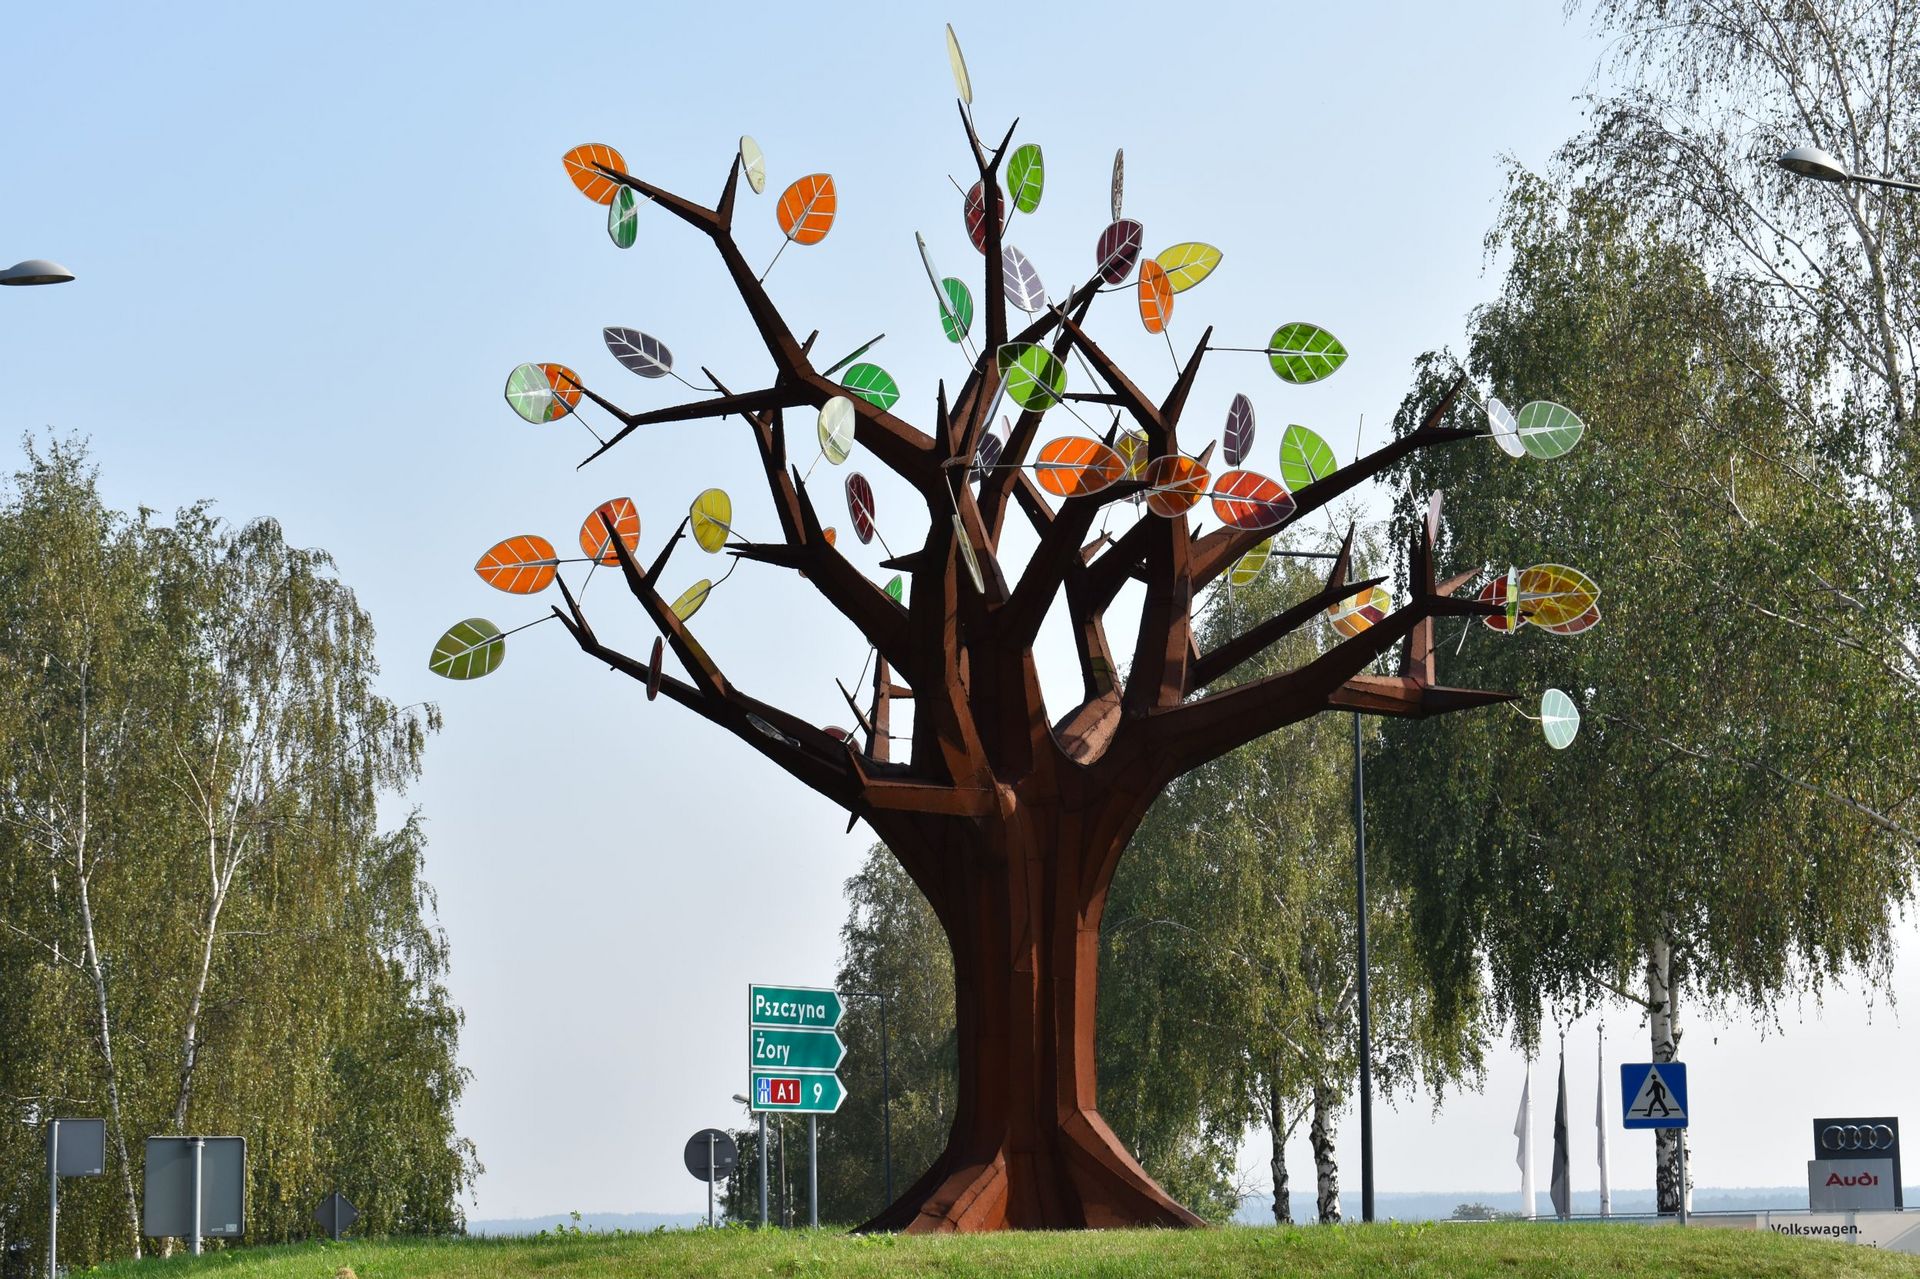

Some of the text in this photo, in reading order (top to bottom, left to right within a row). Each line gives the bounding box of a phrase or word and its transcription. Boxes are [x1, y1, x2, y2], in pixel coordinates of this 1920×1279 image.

[756, 995, 825, 1024] Pszczyna
[756, 1032, 790, 1065] Żory
[777, 1082, 823, 1104] A1 9
[1825, 1172, 1879, 1187] Audi
